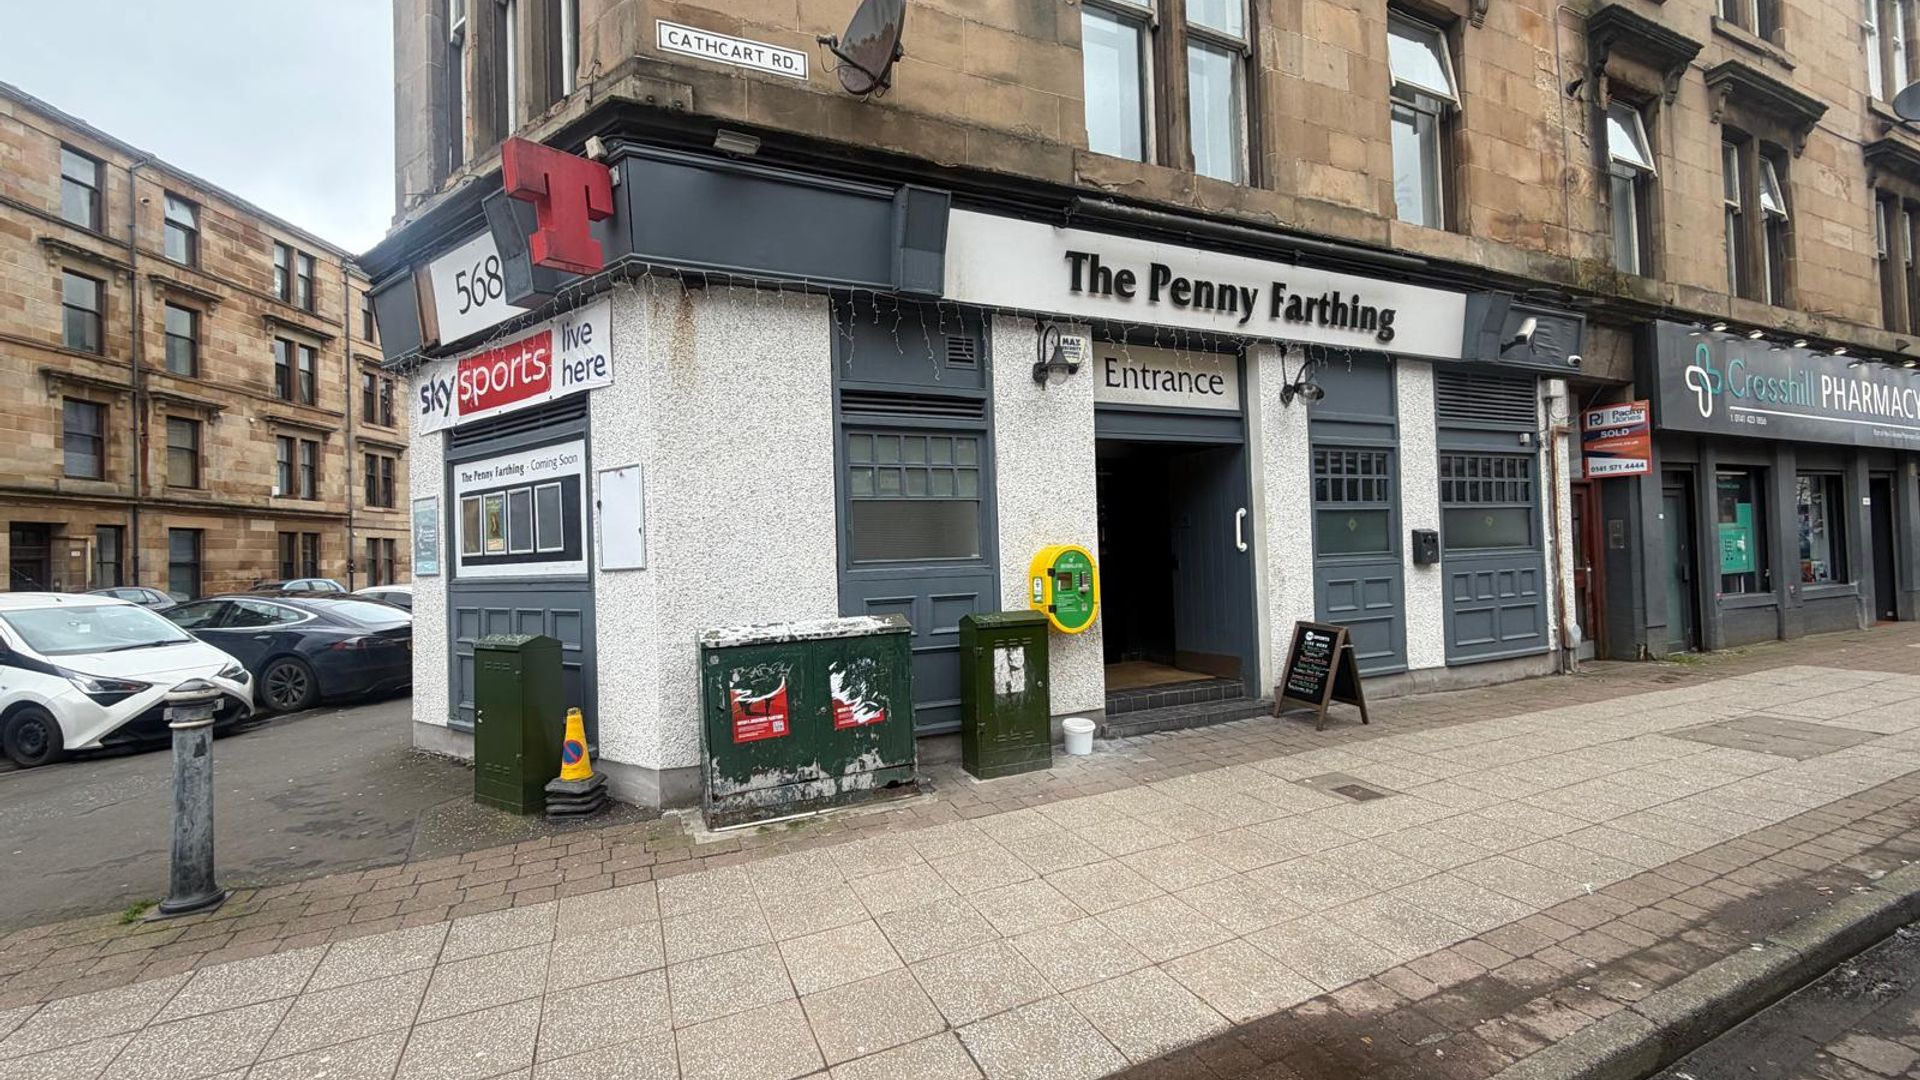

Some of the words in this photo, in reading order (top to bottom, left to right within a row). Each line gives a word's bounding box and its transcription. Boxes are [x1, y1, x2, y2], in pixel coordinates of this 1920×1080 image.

[668, 31, 765, 63] CATHCART
[771, 53, 798, 71] RD.
[455, 255, 503, 315] 568
[1064, 250, 1137, 298] The
[1148, 262, 1259, 324] Penny
[1269, 281, 1397, 341] Farthing
[562, 322, 592, 352] live
[420, 373, 455, 418] sky
[460, 347, 546, 406] sports
[562, 354, 606, 387] here
[1104, 357, 1224, 395] Entrance
[1728, 359, 1816, 408] Crosshill
[1601, 428, 1630, 438] SOLD
[462, 471, 473, 483] The
[474, 469, 494, 481] Penny
[495, 463, 525, 476] Farthing
[531, 457, 558, 471] Coming
[559, 453, 579, 466] Soon
